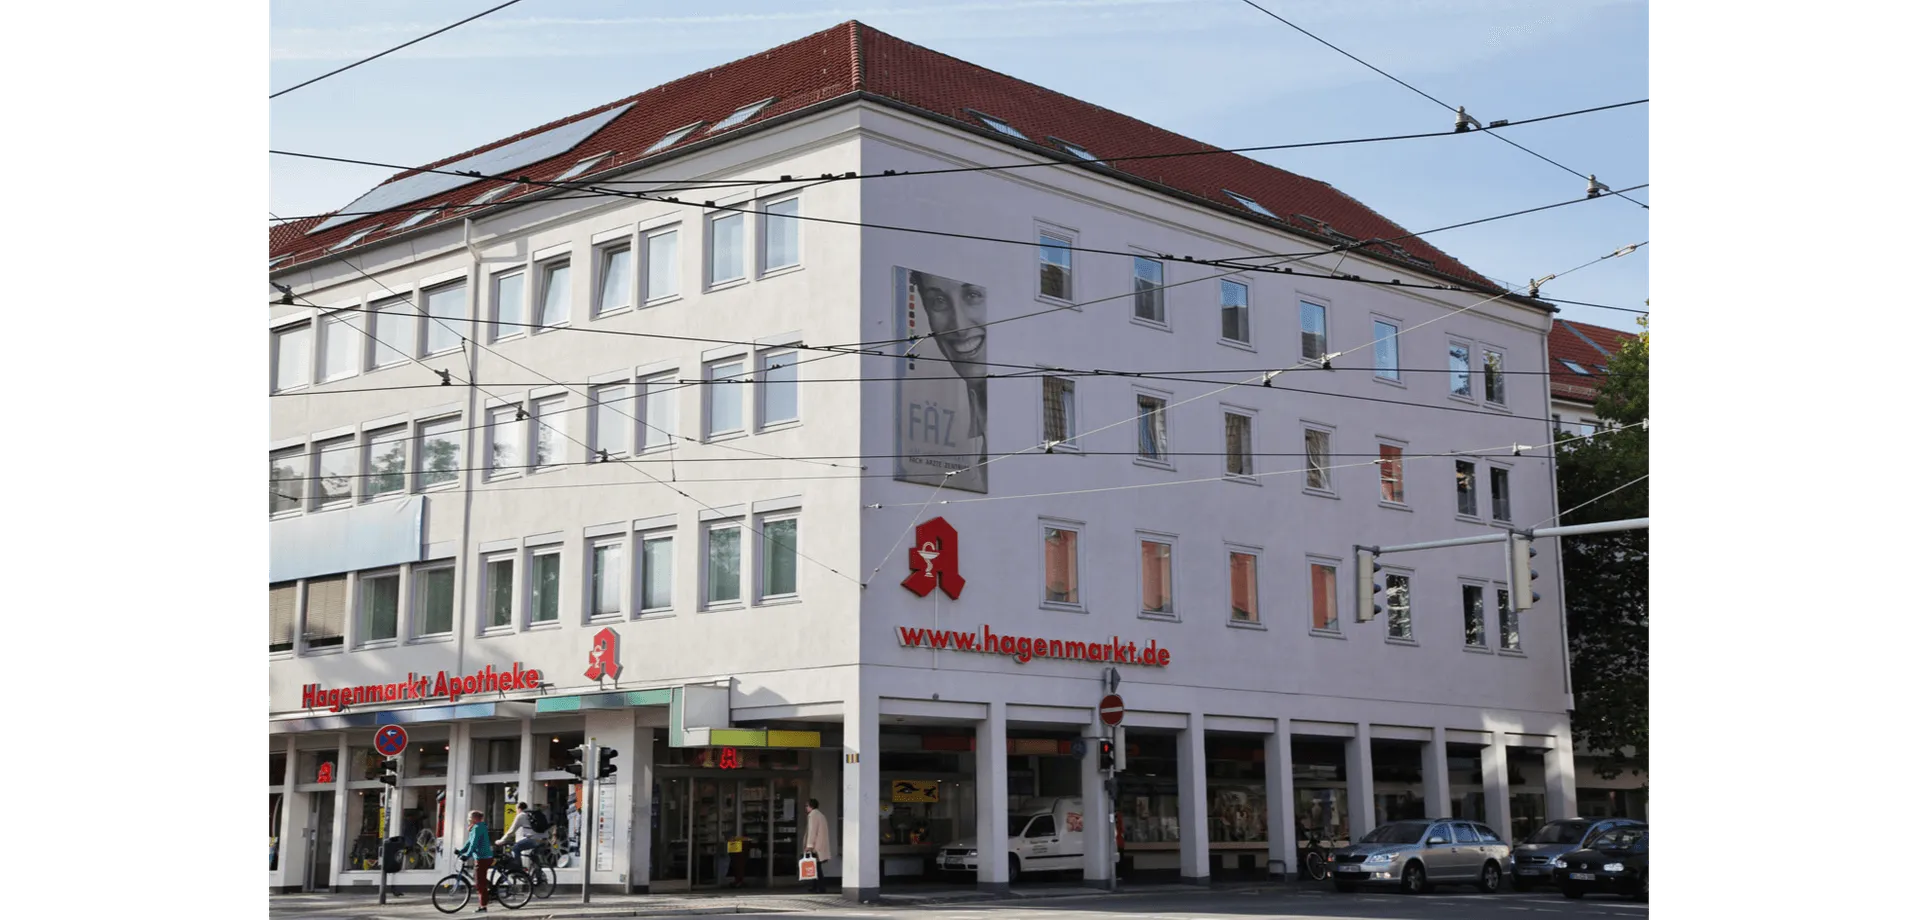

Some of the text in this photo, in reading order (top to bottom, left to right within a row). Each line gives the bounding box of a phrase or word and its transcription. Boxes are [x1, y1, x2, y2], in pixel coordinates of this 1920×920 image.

[908, 401, 956, 447] FÄZ
[898, 624, 1171, 666] www.hagenmarkt.de
[302, 662, 541, 713] Hagenmarkt Apotheke
